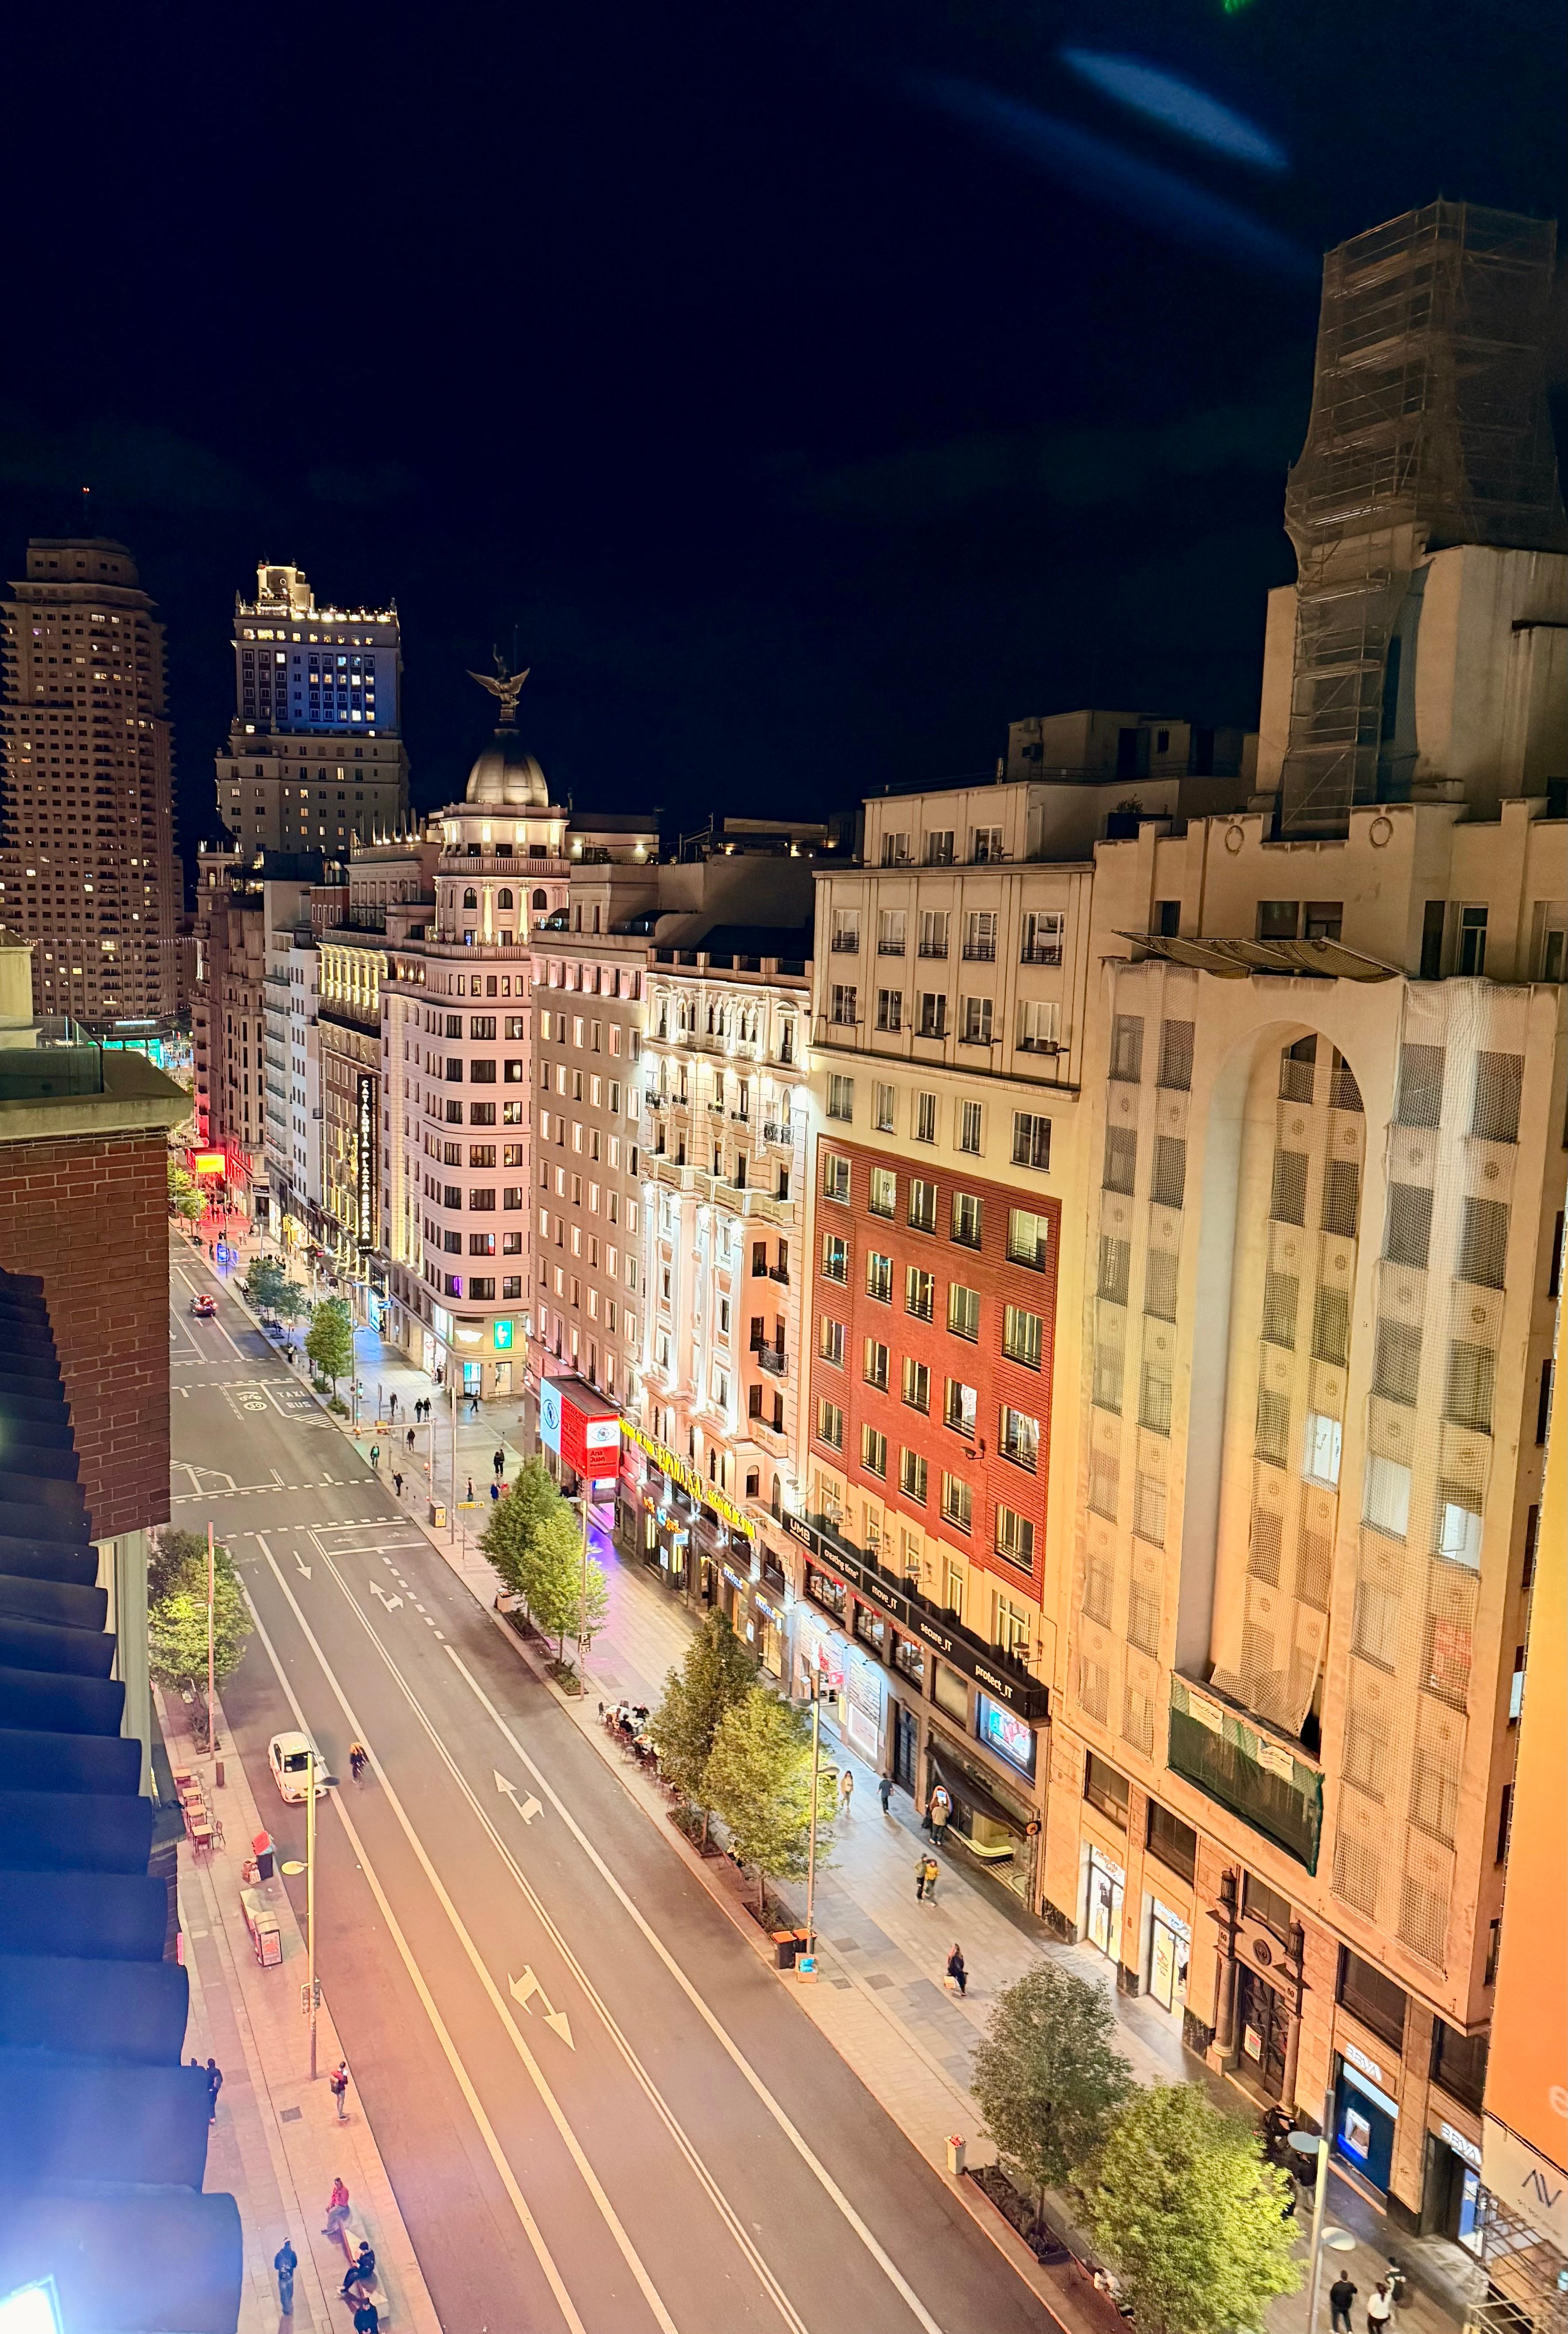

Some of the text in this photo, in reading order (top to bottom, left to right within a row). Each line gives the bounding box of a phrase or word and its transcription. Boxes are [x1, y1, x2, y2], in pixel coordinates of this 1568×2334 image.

[790, 1518, 810, 1541] UMB
[825, 1549, 844, 1571] creating
[872, 1585, 898, 1610] move_IT
[581, 1634, 588, 1643] P
[920, 1623, 952, 1652] secure_IT
[975, 1665, 1013, 1698] protect_IT
[1346, 2043, 1382, 2081] BBVA
[1441, 2122, 1482, 2165] BBVA
